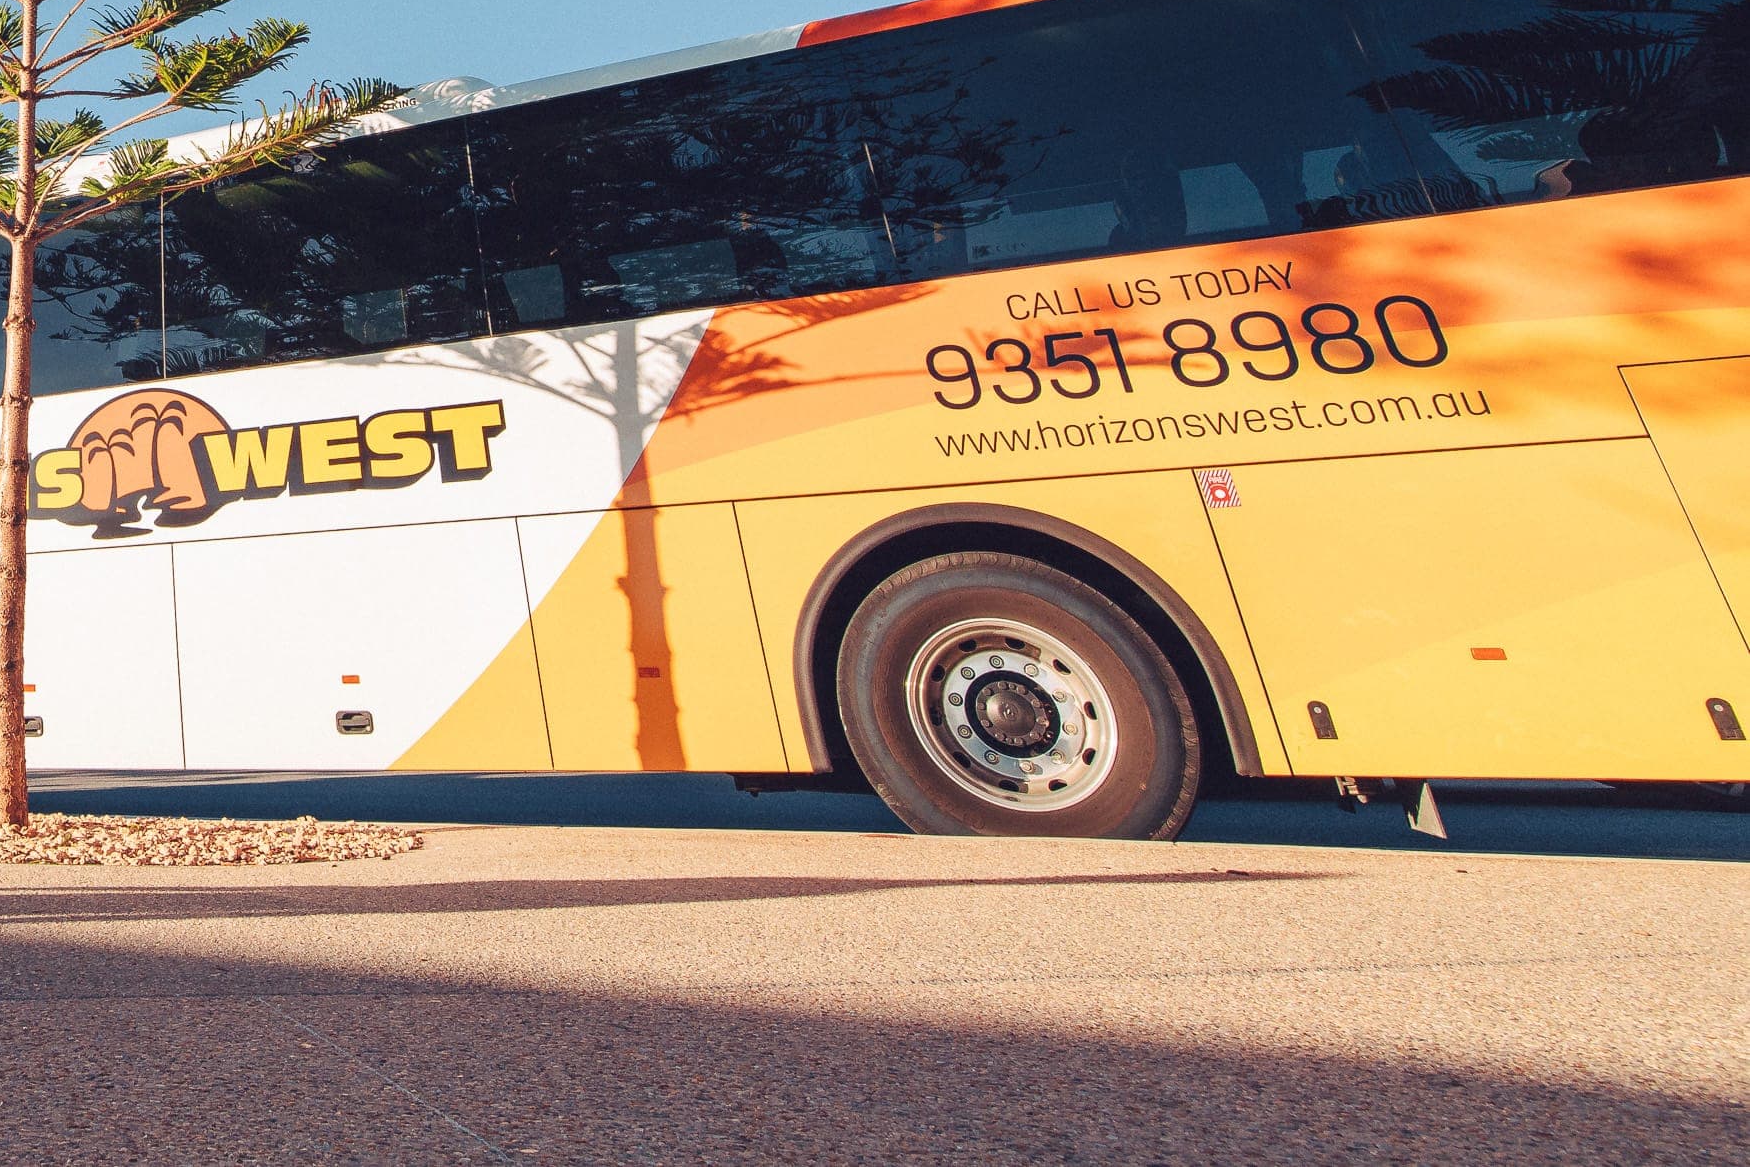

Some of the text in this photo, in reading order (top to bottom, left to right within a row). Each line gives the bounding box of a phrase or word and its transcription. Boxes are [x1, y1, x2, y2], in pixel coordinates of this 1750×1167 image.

[1006, 261, 1293, 321] CALL US TODAY
[926, 295, 1449, 410] 9351 8980
[194, 400, 506, 499] WEST
[934, 389, 1491, 457] www.horizonswest.com.au
